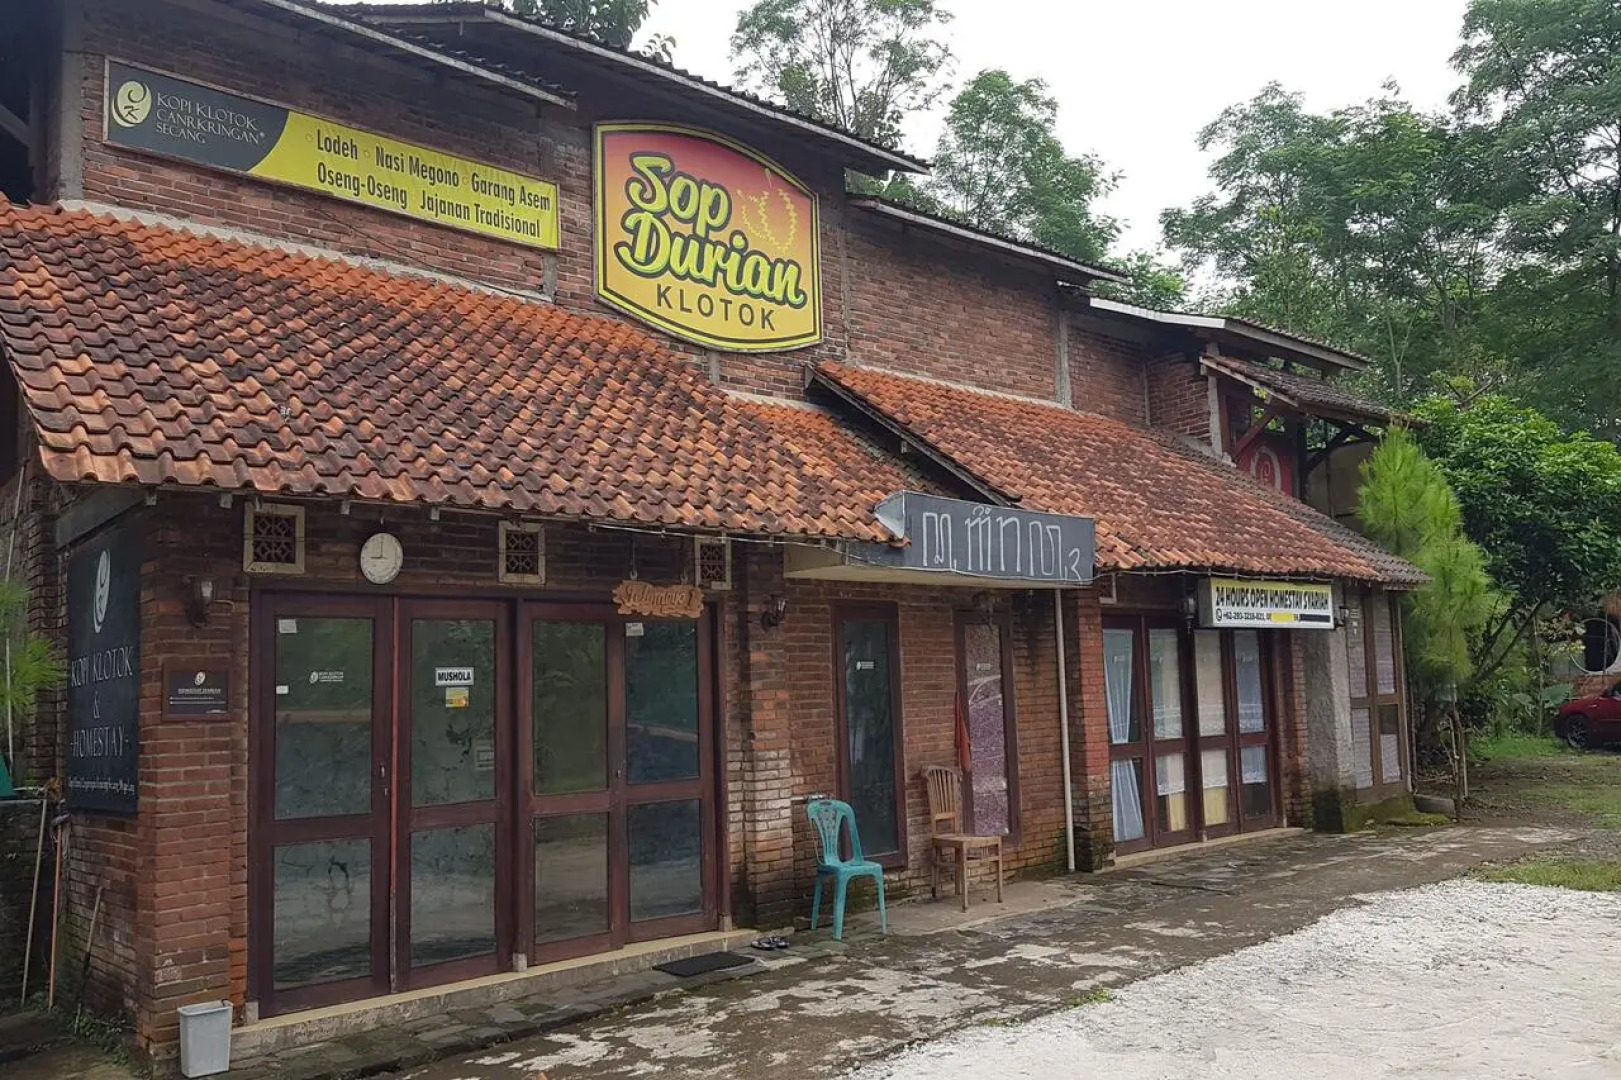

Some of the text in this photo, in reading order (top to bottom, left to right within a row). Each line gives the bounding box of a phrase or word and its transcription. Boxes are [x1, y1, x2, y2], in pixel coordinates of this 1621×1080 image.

[156, 92, 258, 131] KOPI KLOTOK
[156, 122, 206, 144] SECANG
[317, 129, 550, 212] Lodeh Nasi Megono Garang Asem
[317, 162, 541, 238] Oseng-Oseng Jajanan Tradisional
[627, 153, 731, 238] Sop
[615, 208, 806, 307] Durian
[656, 283, 776, 331] KLOTOK
[1216, 586, 1329, 610] 24 HOURS OPEN HOMESTAY SYARIAH
[71, 646, 133, 688] KOPI KLOTOK
[437, 671, 472, 681] MUSHOLA
[92, 689, 101, 719] &
